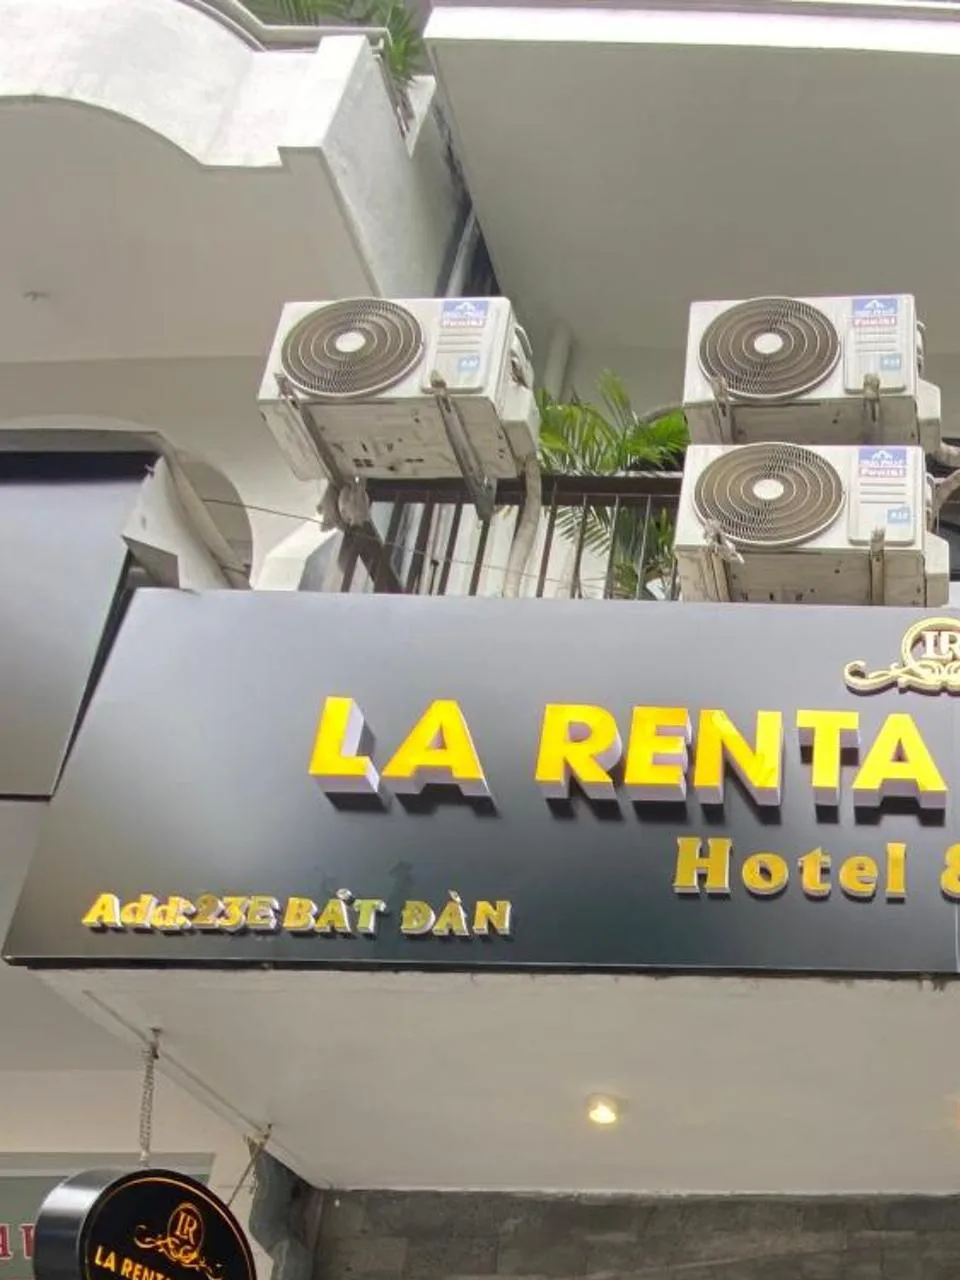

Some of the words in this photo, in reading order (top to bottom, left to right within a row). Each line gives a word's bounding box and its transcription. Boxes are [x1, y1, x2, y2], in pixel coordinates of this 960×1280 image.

[309, 697, 491, 800] LA
[535, 704, 948, 808] RENTA
[674, 837, 905, 899] Hotel
[400, 889, 512, 936] ĐÀN
[94, 1245, 116, 1272] LA
